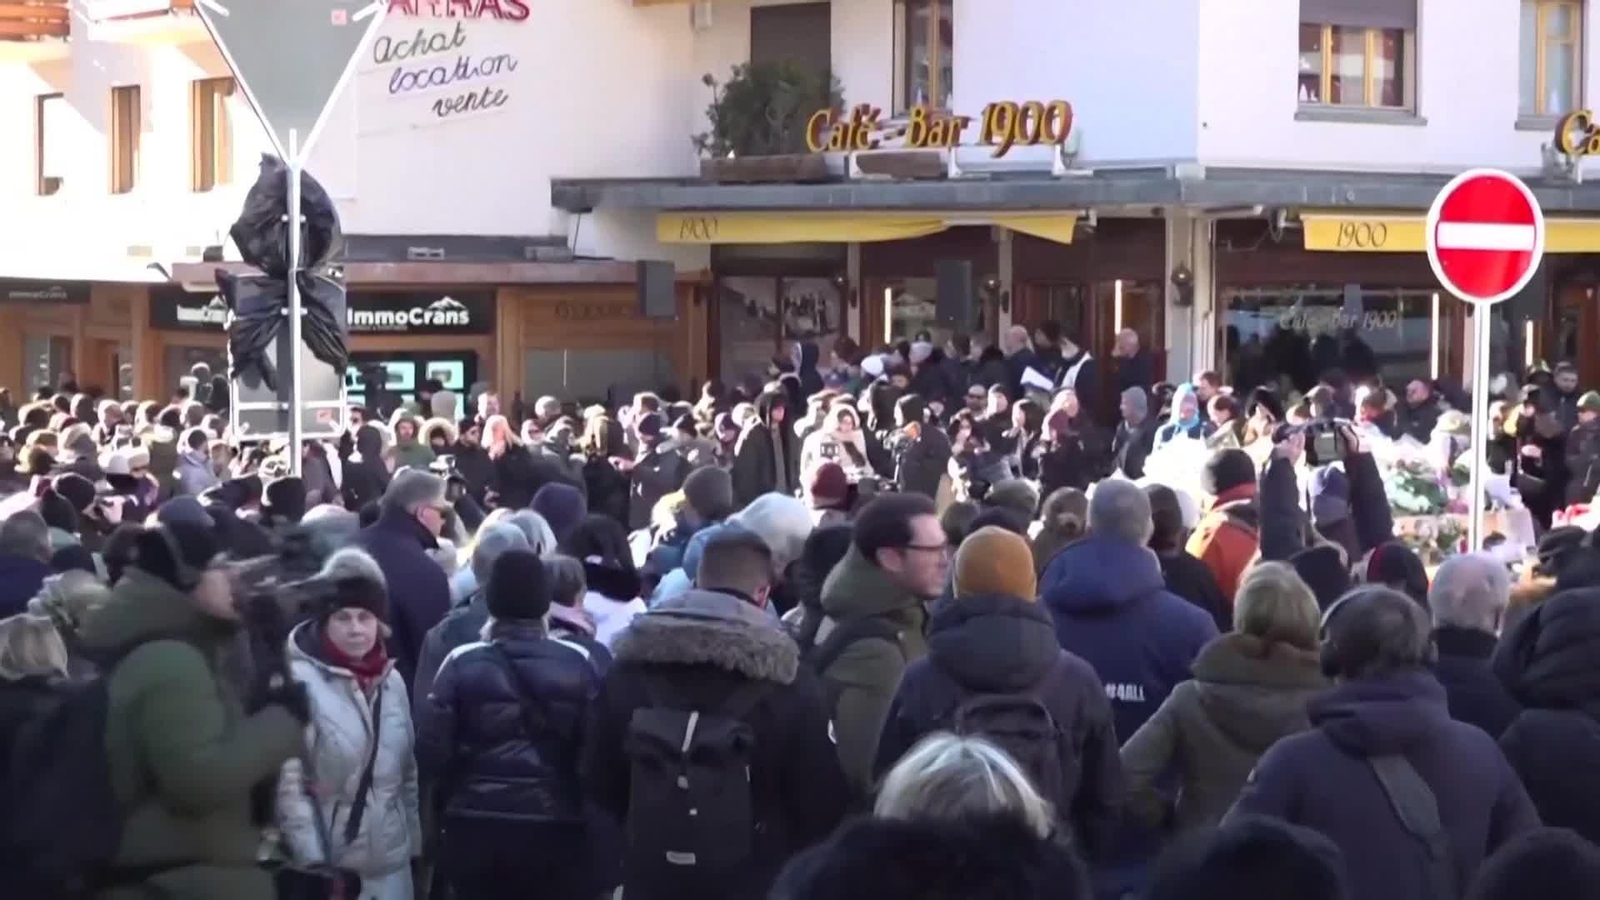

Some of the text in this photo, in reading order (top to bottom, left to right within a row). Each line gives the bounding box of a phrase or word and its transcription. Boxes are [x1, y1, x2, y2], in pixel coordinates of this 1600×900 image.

[432, 86, 509, 117] vente
[907, 105, 970, 147] Bar
[977, 99, 1073, 158] 1900
[1335, 221, 1387, 248] 1900
[347, 307, 470, 325] ImmoCrans
[1363, 311, 1397, 331] 1900
